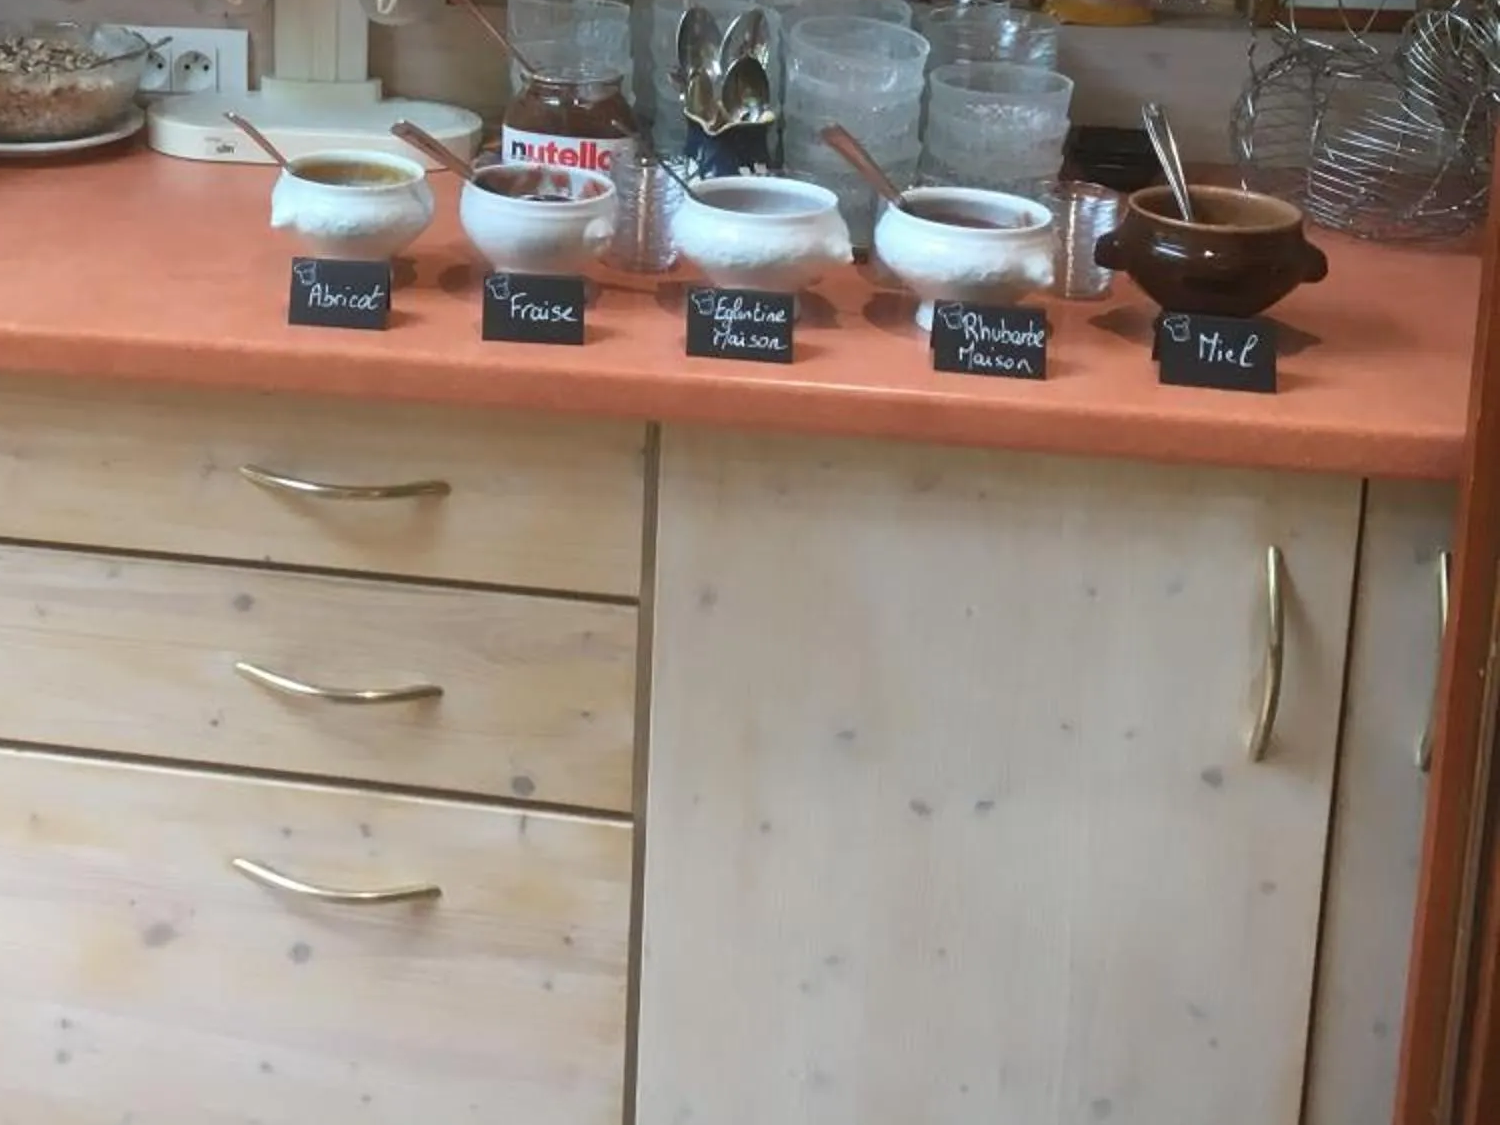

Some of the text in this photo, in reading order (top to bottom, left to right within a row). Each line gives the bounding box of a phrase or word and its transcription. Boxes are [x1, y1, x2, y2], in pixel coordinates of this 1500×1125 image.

[307, 282, 385, 311] Abricot
[510, 291, 579, 322] Fraise
[713, 295, 788, 334] Eglantine
[712, 327, 789, 351] Maison
[961, 311, 1046, 349] Rhubarbe
[958, 339, 1034, 375] Maison
[1199, 331, 1259, 369] Miel
